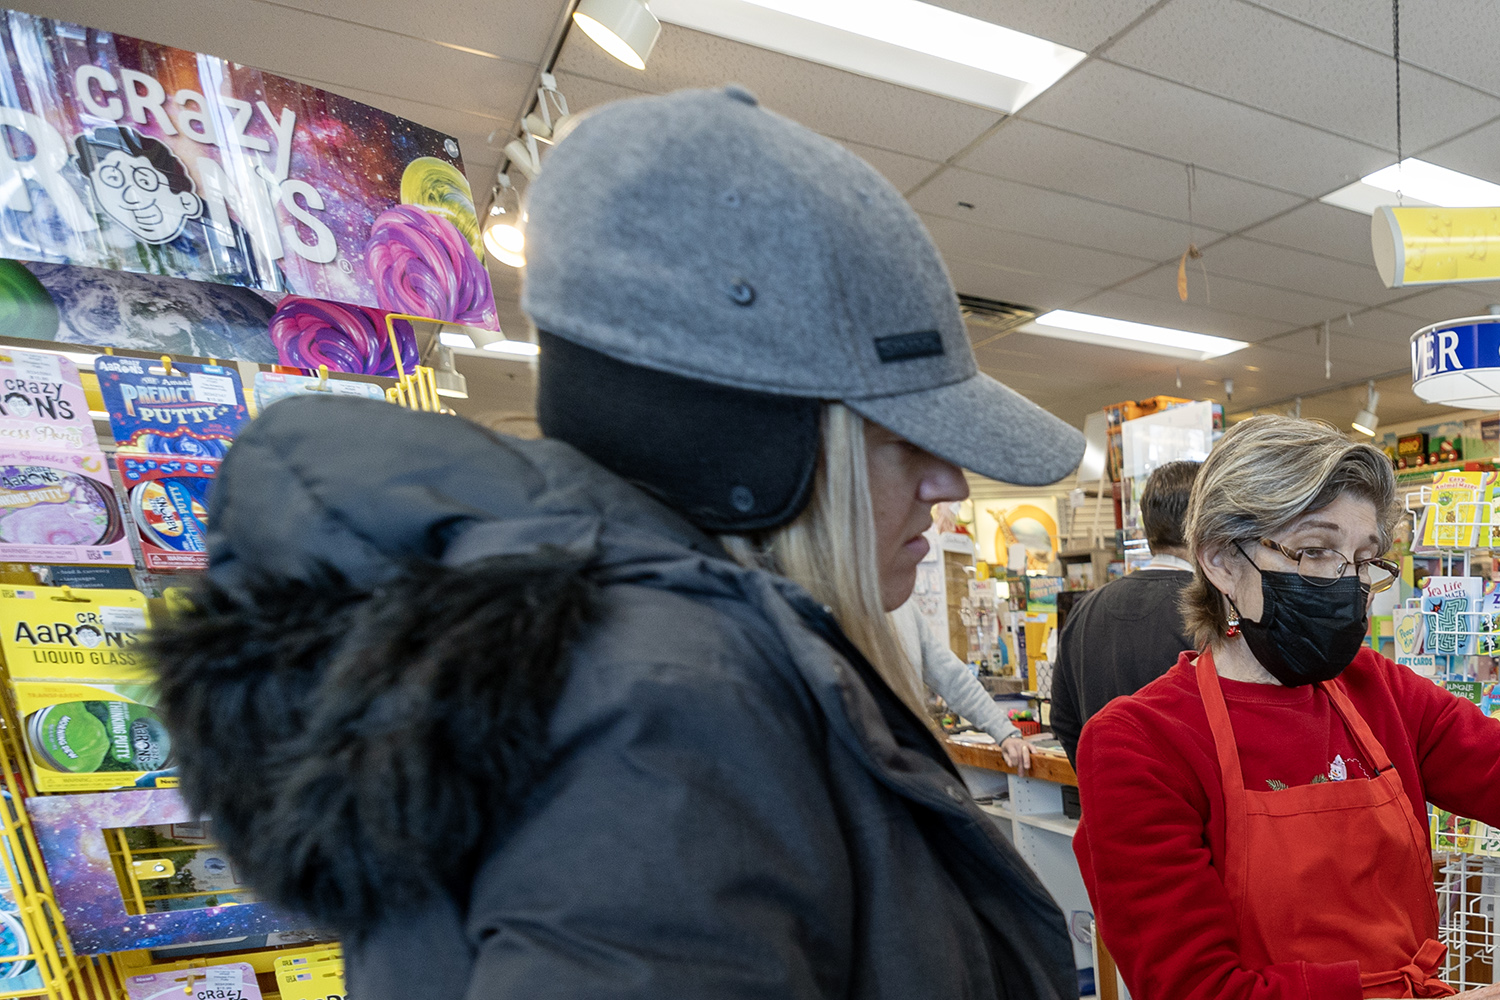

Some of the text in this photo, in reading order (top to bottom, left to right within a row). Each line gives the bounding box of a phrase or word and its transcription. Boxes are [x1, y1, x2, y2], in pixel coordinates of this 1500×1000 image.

[162, 378, 192, 386] Amazi
[119, 383, 194, 417] PREDICT
[138, 406, 218, 424] PUTTY
[30, 487, 66, 502] PUTTY
[1427, 581, 1462, 597] Sea Life
[1445, 590, 1466, 598] MAZES
[76, 612, 103, 625] cRa
[33, 650, 137, 665] LIQUID GLASS
[1398, 657, 1433, 666] GIFT CARDS
[113, 735, 131, 759] PUTTY
